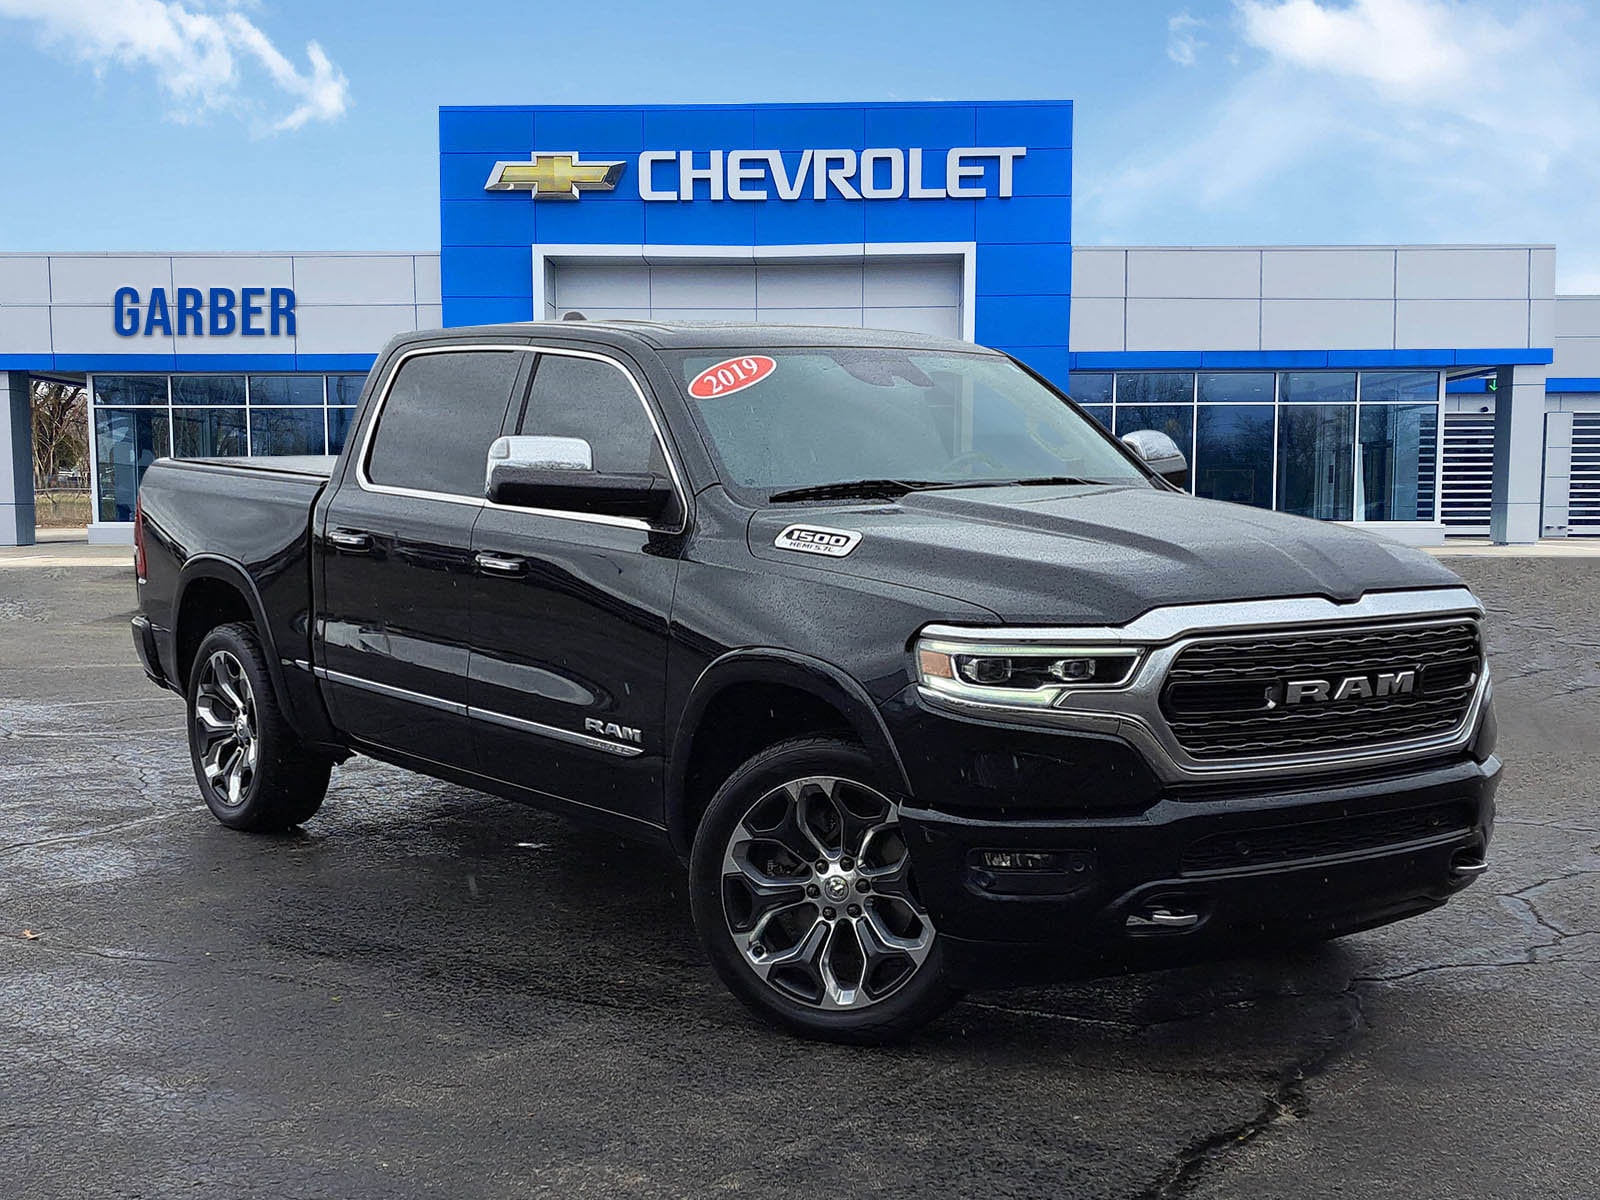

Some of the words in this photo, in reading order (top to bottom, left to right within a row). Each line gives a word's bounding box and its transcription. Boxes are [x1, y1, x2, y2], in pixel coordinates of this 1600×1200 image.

[638, 146, 1027, 201] CHEVROLET
[114, 286, 297, 337] GARBER
[703, 358, 758, 394] 2019
[789, 541, 813, 550] HEMI
[791, 529, 848, 547] 1500
[1285, 670, 1415, 704] RAM
[584, 717, 641, 743] RAM
